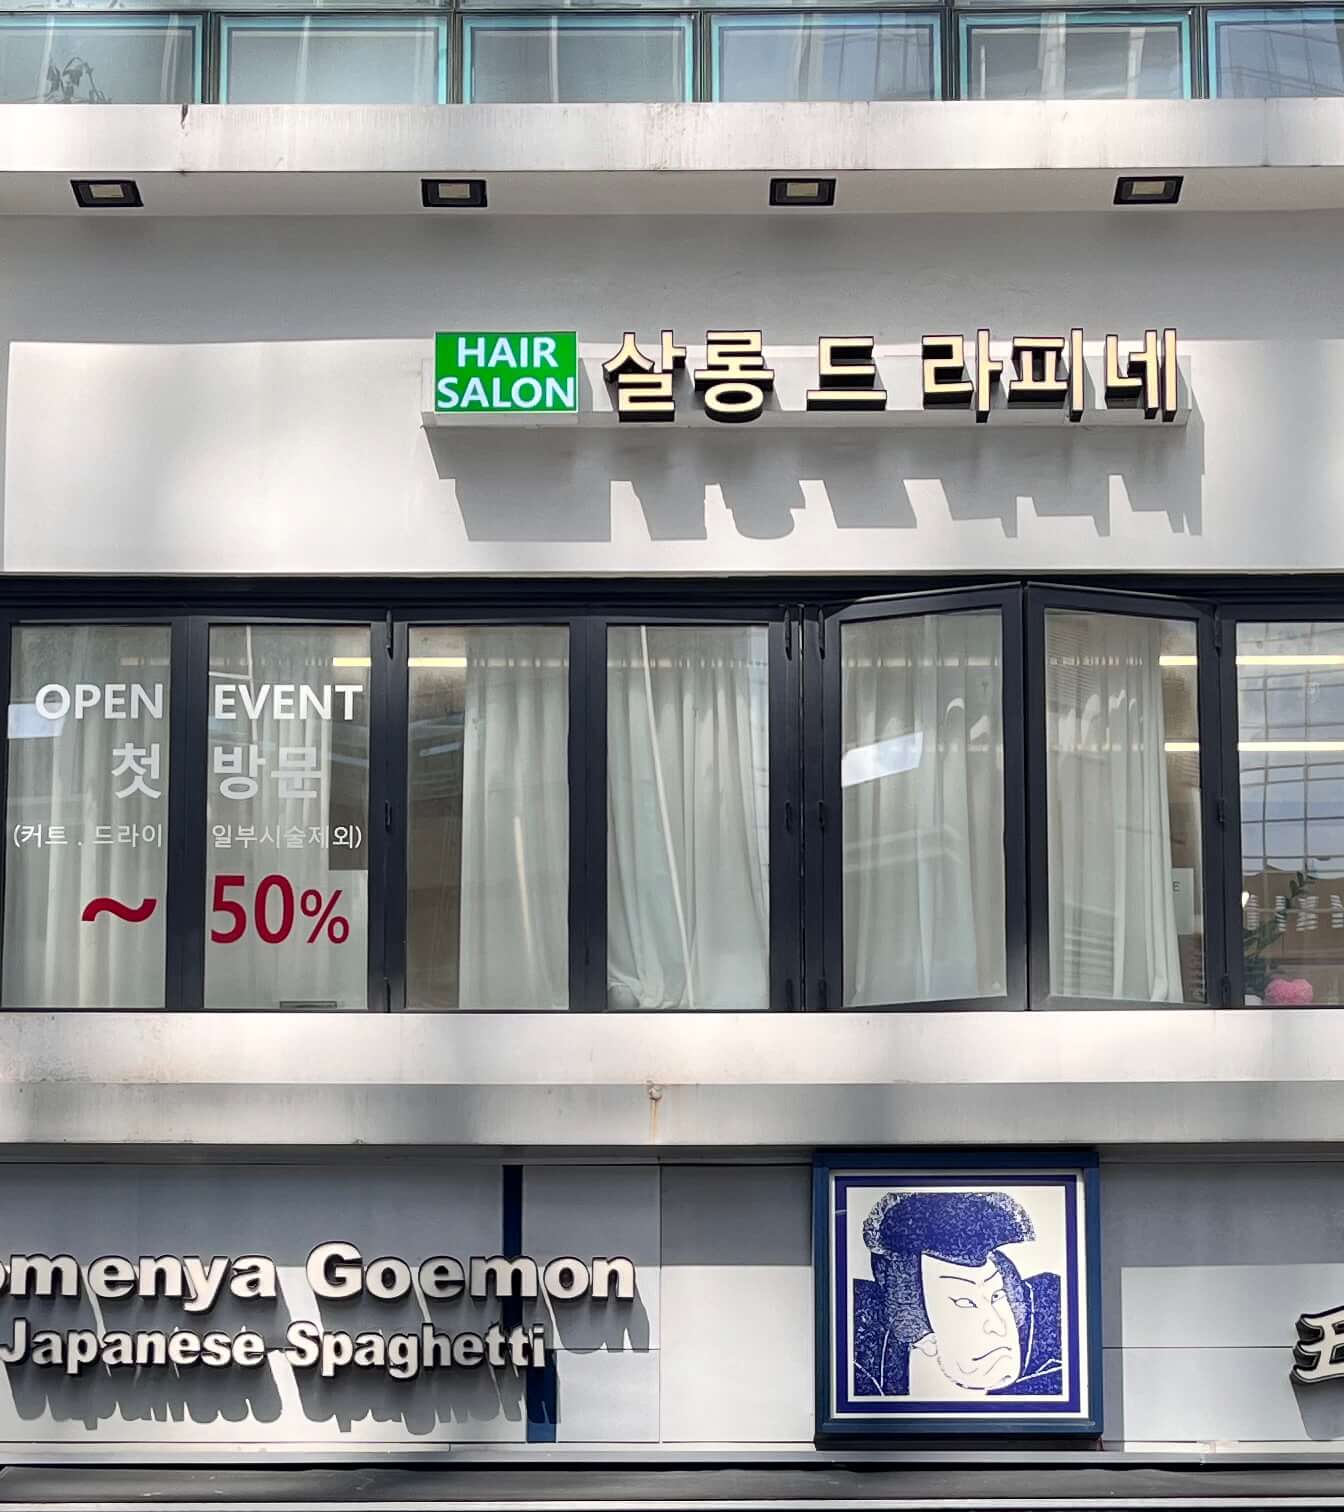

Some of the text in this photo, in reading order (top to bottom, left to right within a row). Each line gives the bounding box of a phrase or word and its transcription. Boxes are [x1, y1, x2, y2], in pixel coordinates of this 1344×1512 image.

[455, 336, 558, 368] HAIR
[604, 329, 775, 423] 살롱
[922, 328, 1178, 423] 라피네
[436, 376, 575, 410] SALON
[35, 683, 364, 721] OPEN EVENT
[111, 742, 324, 800] 첫 방문
[13, 823, 363, 850] (커트 드라이 일부시술제외)
[210, 873, 350, 945] 50%
[305, 1241, 638, 1302] Goemon
[283, 1320, 547, 1380] Spaghetti
